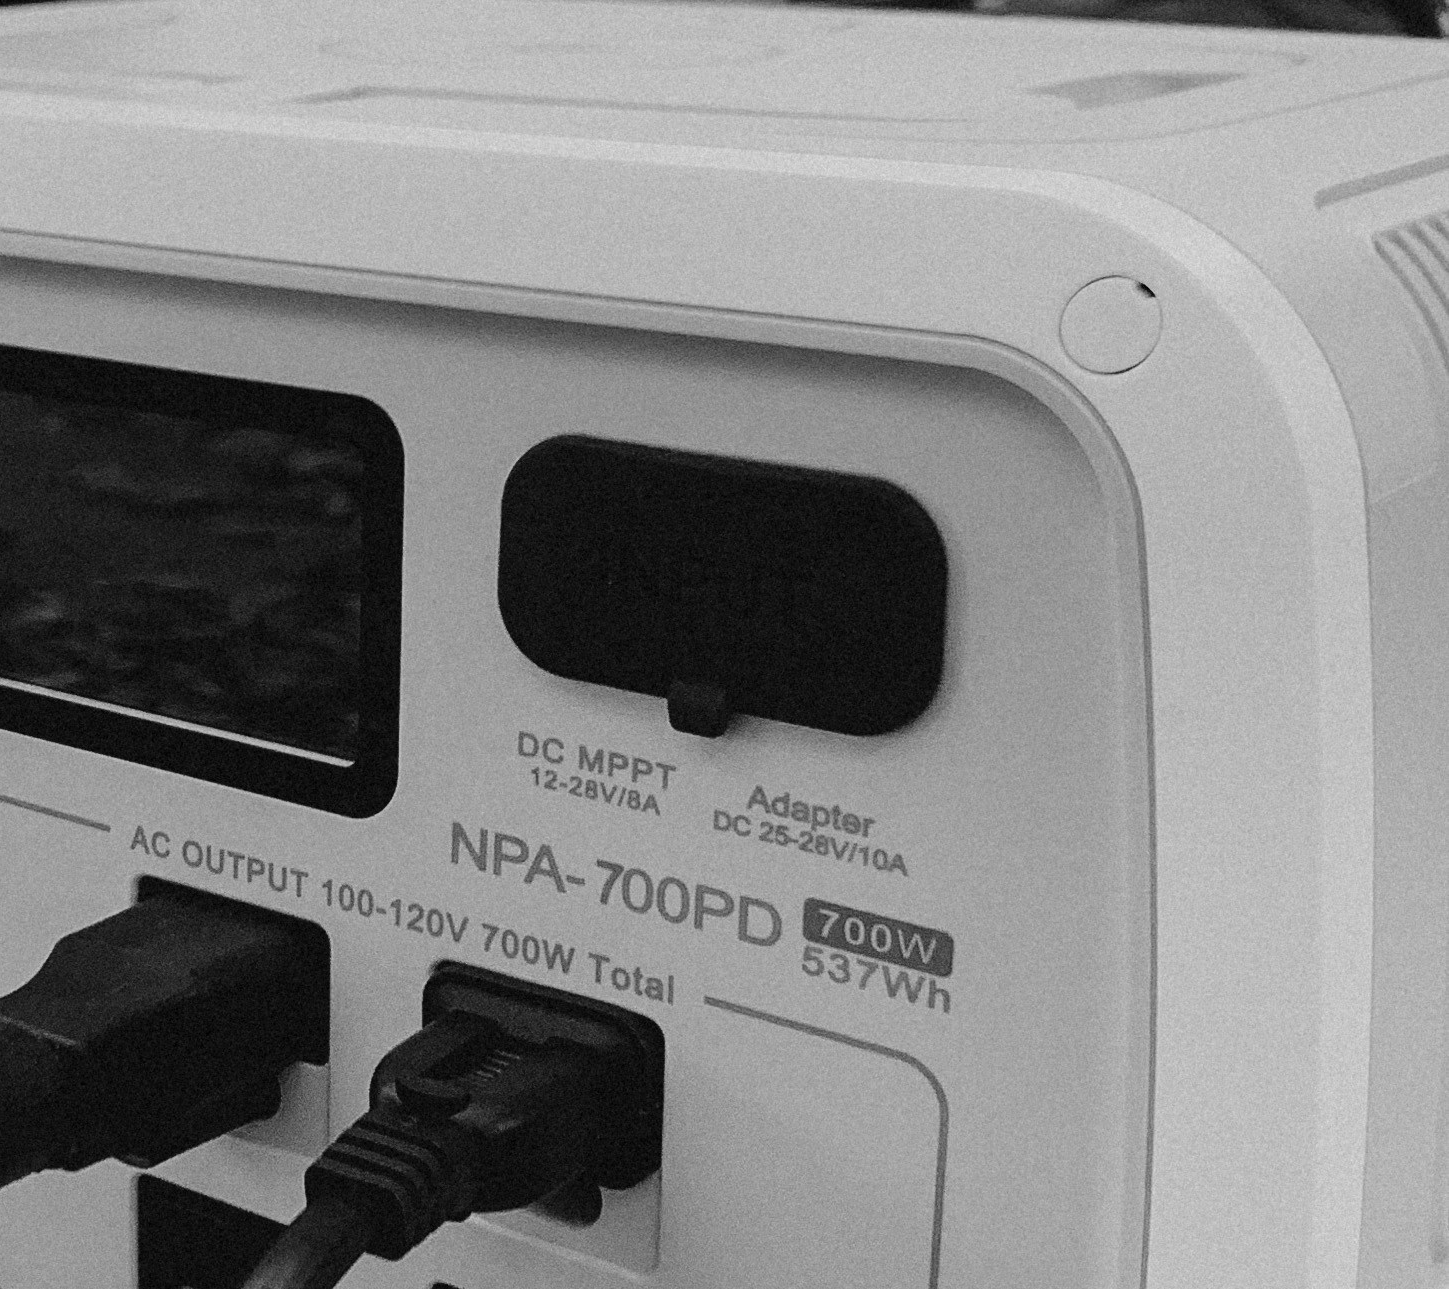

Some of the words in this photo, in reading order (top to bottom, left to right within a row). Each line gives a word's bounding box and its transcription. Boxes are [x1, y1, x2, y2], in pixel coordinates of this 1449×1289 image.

[517, 731, 565, 765] DC
[578, 744, 677, 790] MPPT
[530, 767, 661, 816] 12-28V/8A
[713, 810, 753, 839] DC
[759, 822, 910, 877] 25-28V/10A
[747, 785, 875, 839] Adapter
[130, 824, 172, 860] AC
[183, 838, 308, 898] OUTPUT
[322, 878, 470, 945] 100-120V
[481, 922, 575, 975] 700W
[588, 951, 675, 1007] Total
[450, 820, 783, 949] NPA-700PD
[818, 907, 937, 966] 700W
[801, 945, 952, 1015] 537Wh
